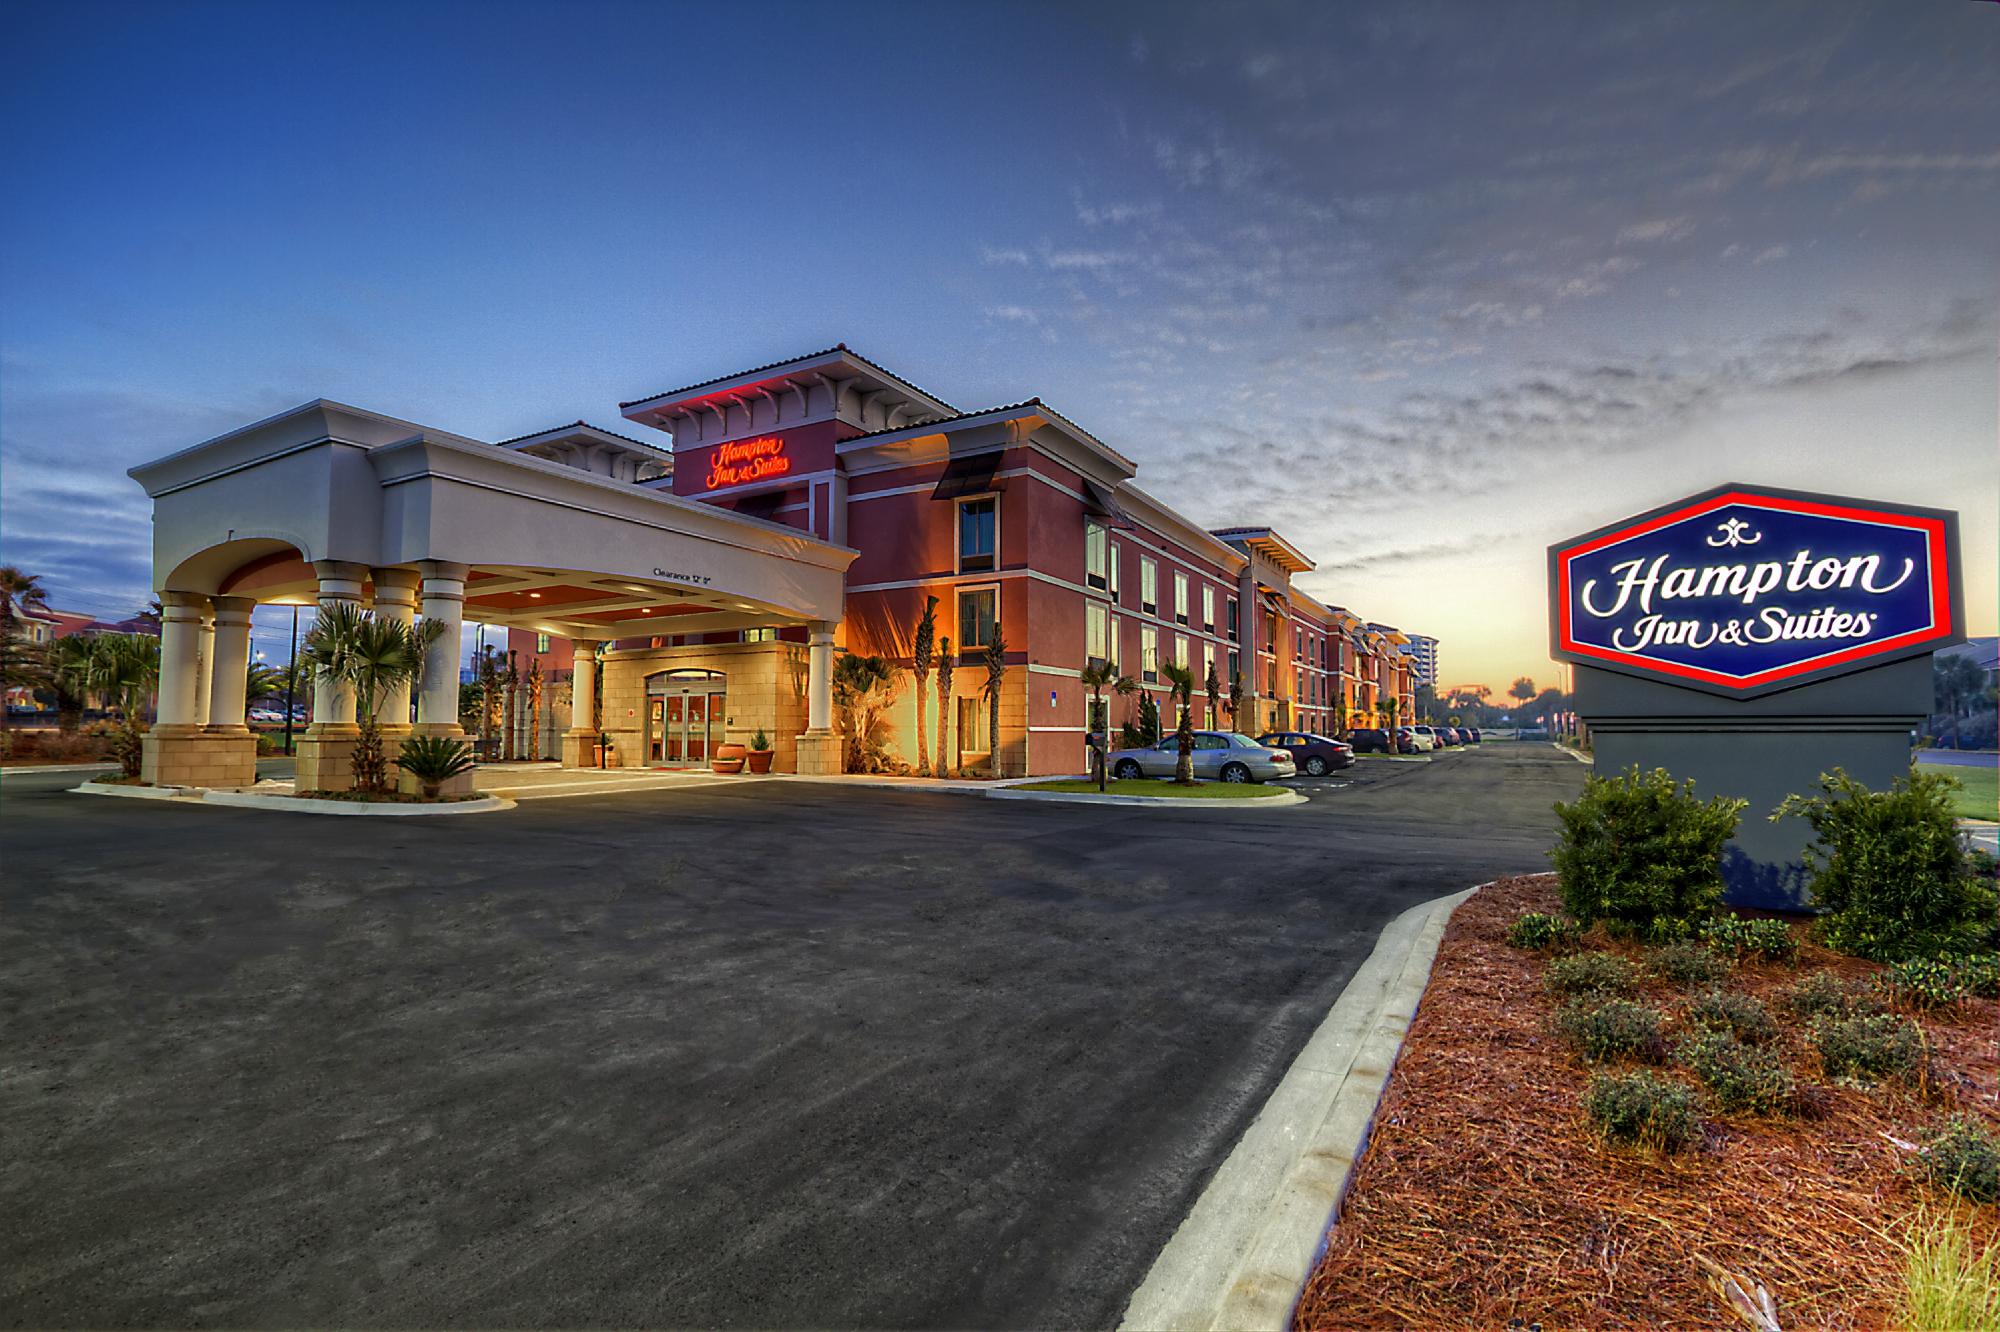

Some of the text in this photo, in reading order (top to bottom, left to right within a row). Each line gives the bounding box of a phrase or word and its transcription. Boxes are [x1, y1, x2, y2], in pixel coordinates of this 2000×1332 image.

[711, 437, 785, 468] Hampton
[706, 466, 741, 489] Inn
[750, 455, 790, 478] Suites
[653, 567, 691, 581] Clearance
[1582, 550, 1914, 616] Hampton
[1613, 606, 1873, 652] Inn & Suites
